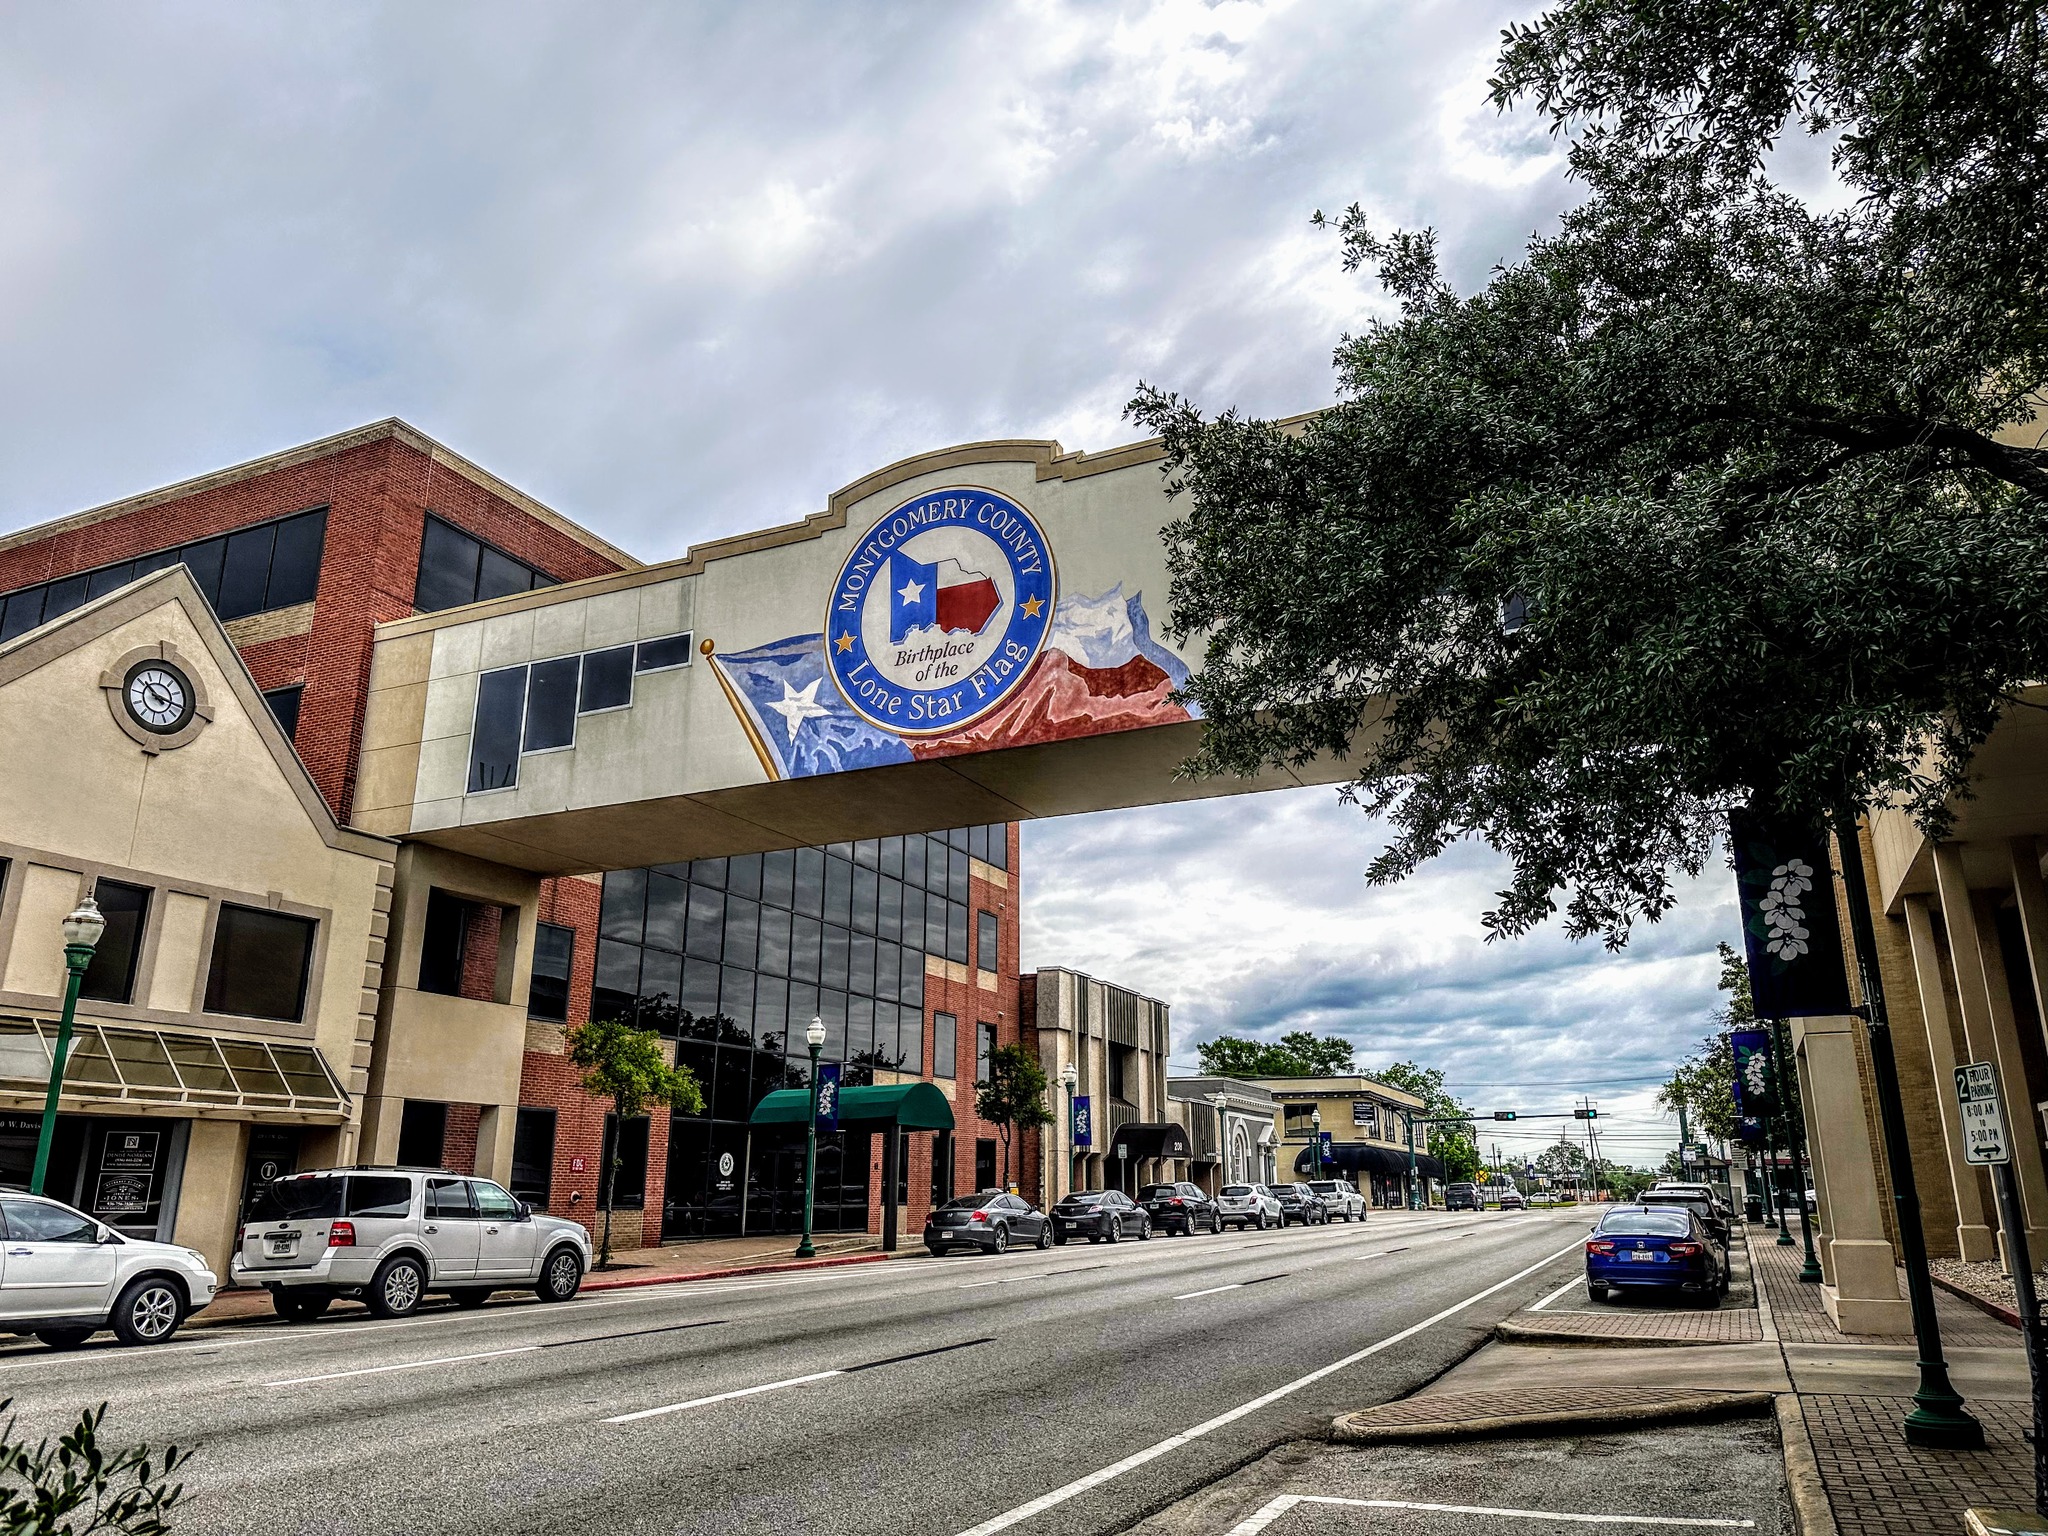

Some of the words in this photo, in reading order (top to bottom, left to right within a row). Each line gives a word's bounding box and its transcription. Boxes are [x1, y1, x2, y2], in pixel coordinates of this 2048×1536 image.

[838, 498, 974, 613] MONTGOMERY
[977, 503, 1042, 576] COUNTY
[894, 641, 975, 667] Birthplace
[847, 660, 902, 716] Lone
[908, 690, 963, 721] Star
[968, 638, 1029, 700] Flag
[915, 665, 933, 682] of
[934, 662, 958, 678] the
[1968, 1067, 1990, 1083] HOUR
[1956, 1074, 1969, 1098] 2
[1970, 1082, 1994, 1098] PARKING
[1966, 1104, 1983, 1117] 8:00
[1985, 1102, 1995, 1115] AM
[20, 1121, 41, 1129] Davis
[1979, 1119, 1987, 1127] TO
[1970, 1130, 1988, 1143] 5:00
[1988, 1128, 1999, 1141] PM
